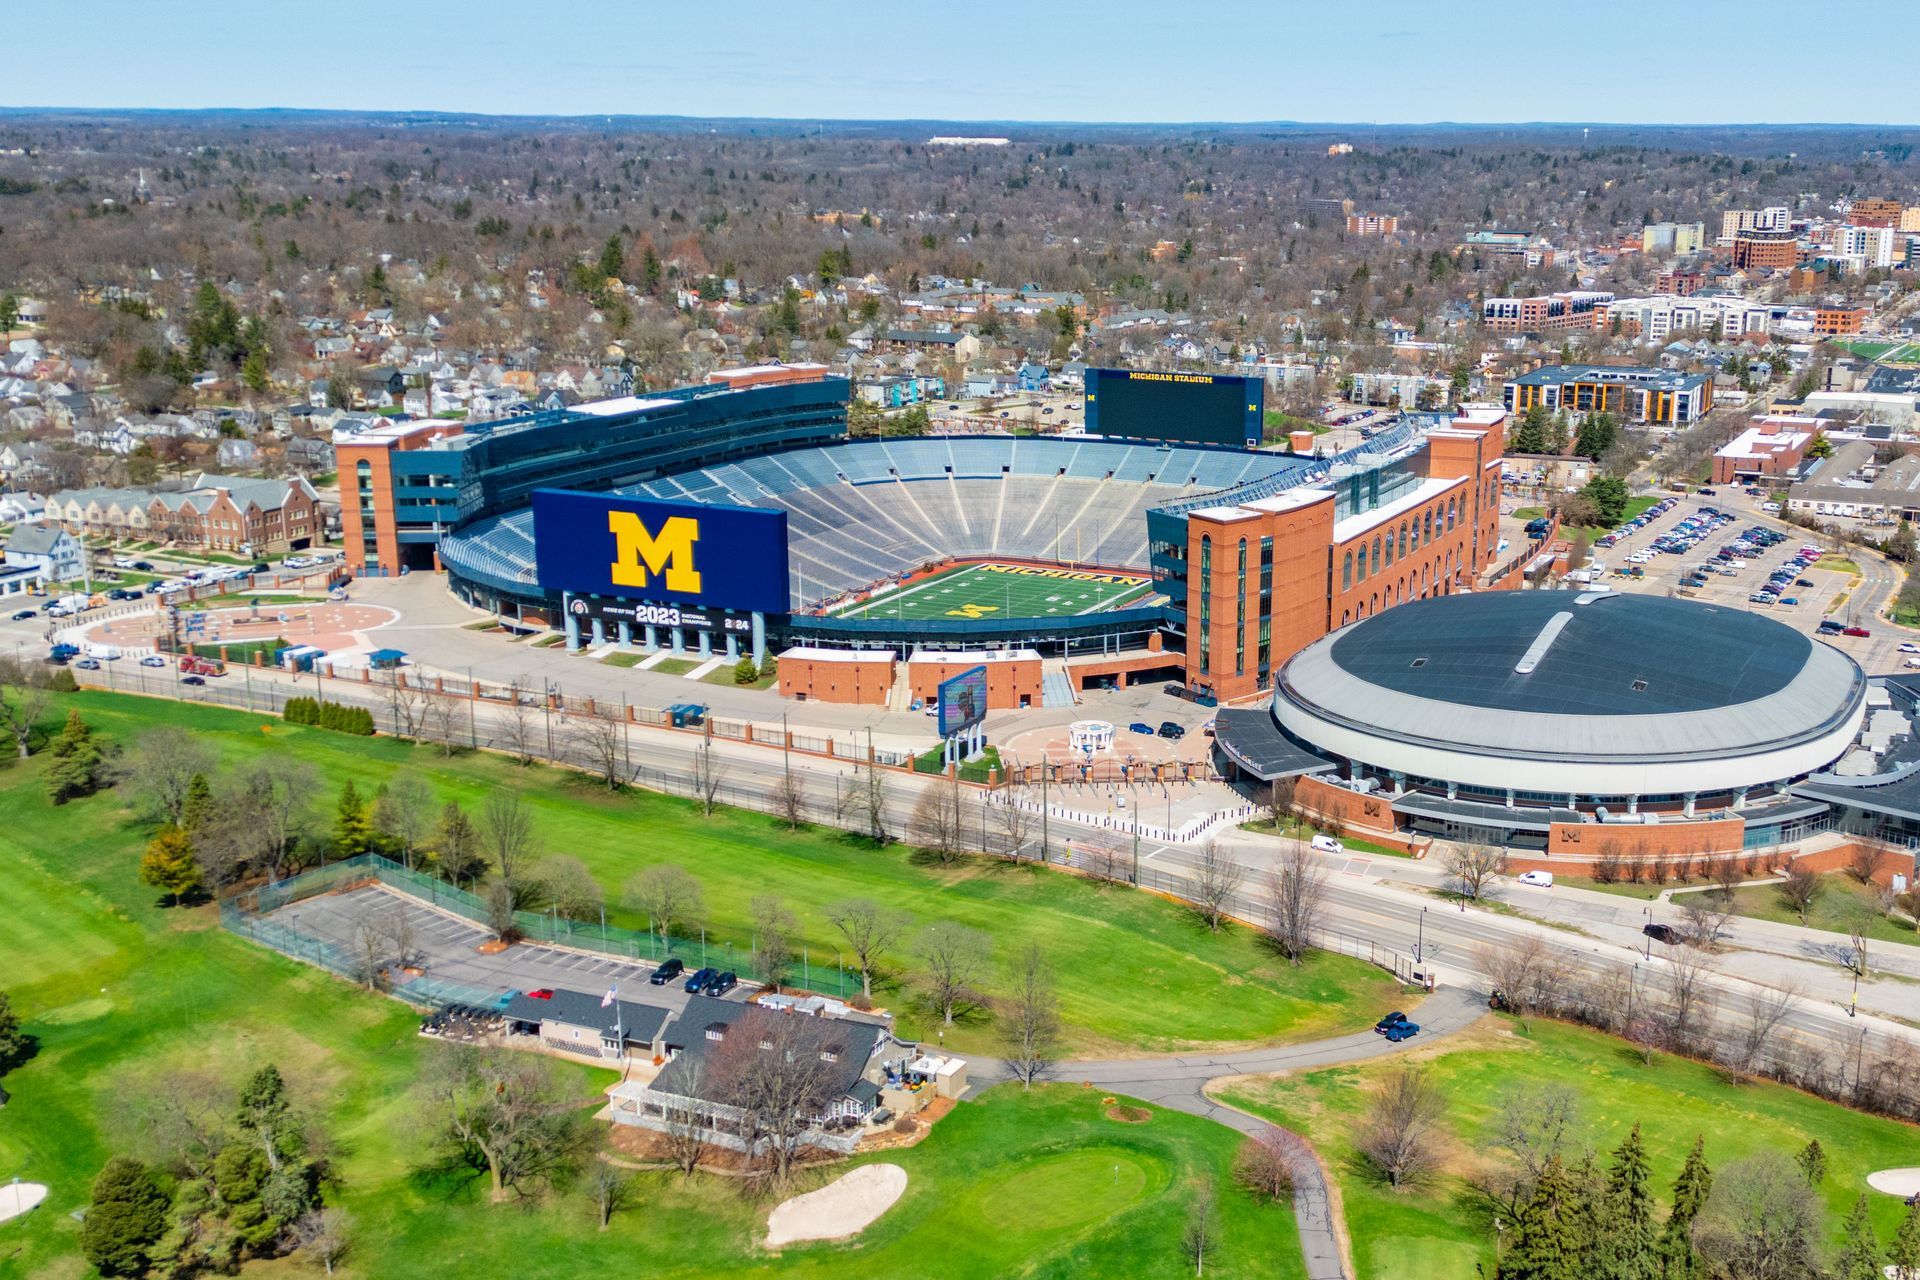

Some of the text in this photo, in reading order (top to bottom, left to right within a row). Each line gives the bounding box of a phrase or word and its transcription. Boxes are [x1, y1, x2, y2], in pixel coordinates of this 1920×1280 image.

[1129, 372, 1213, 384] MICHIGAN STADIUM
[608, 510, 702, 593] M
[979, 564, 1143, 586] MICHIGAN
[636, 605, 680, 626] 2023
[1561, 827, 1581, 843] M
